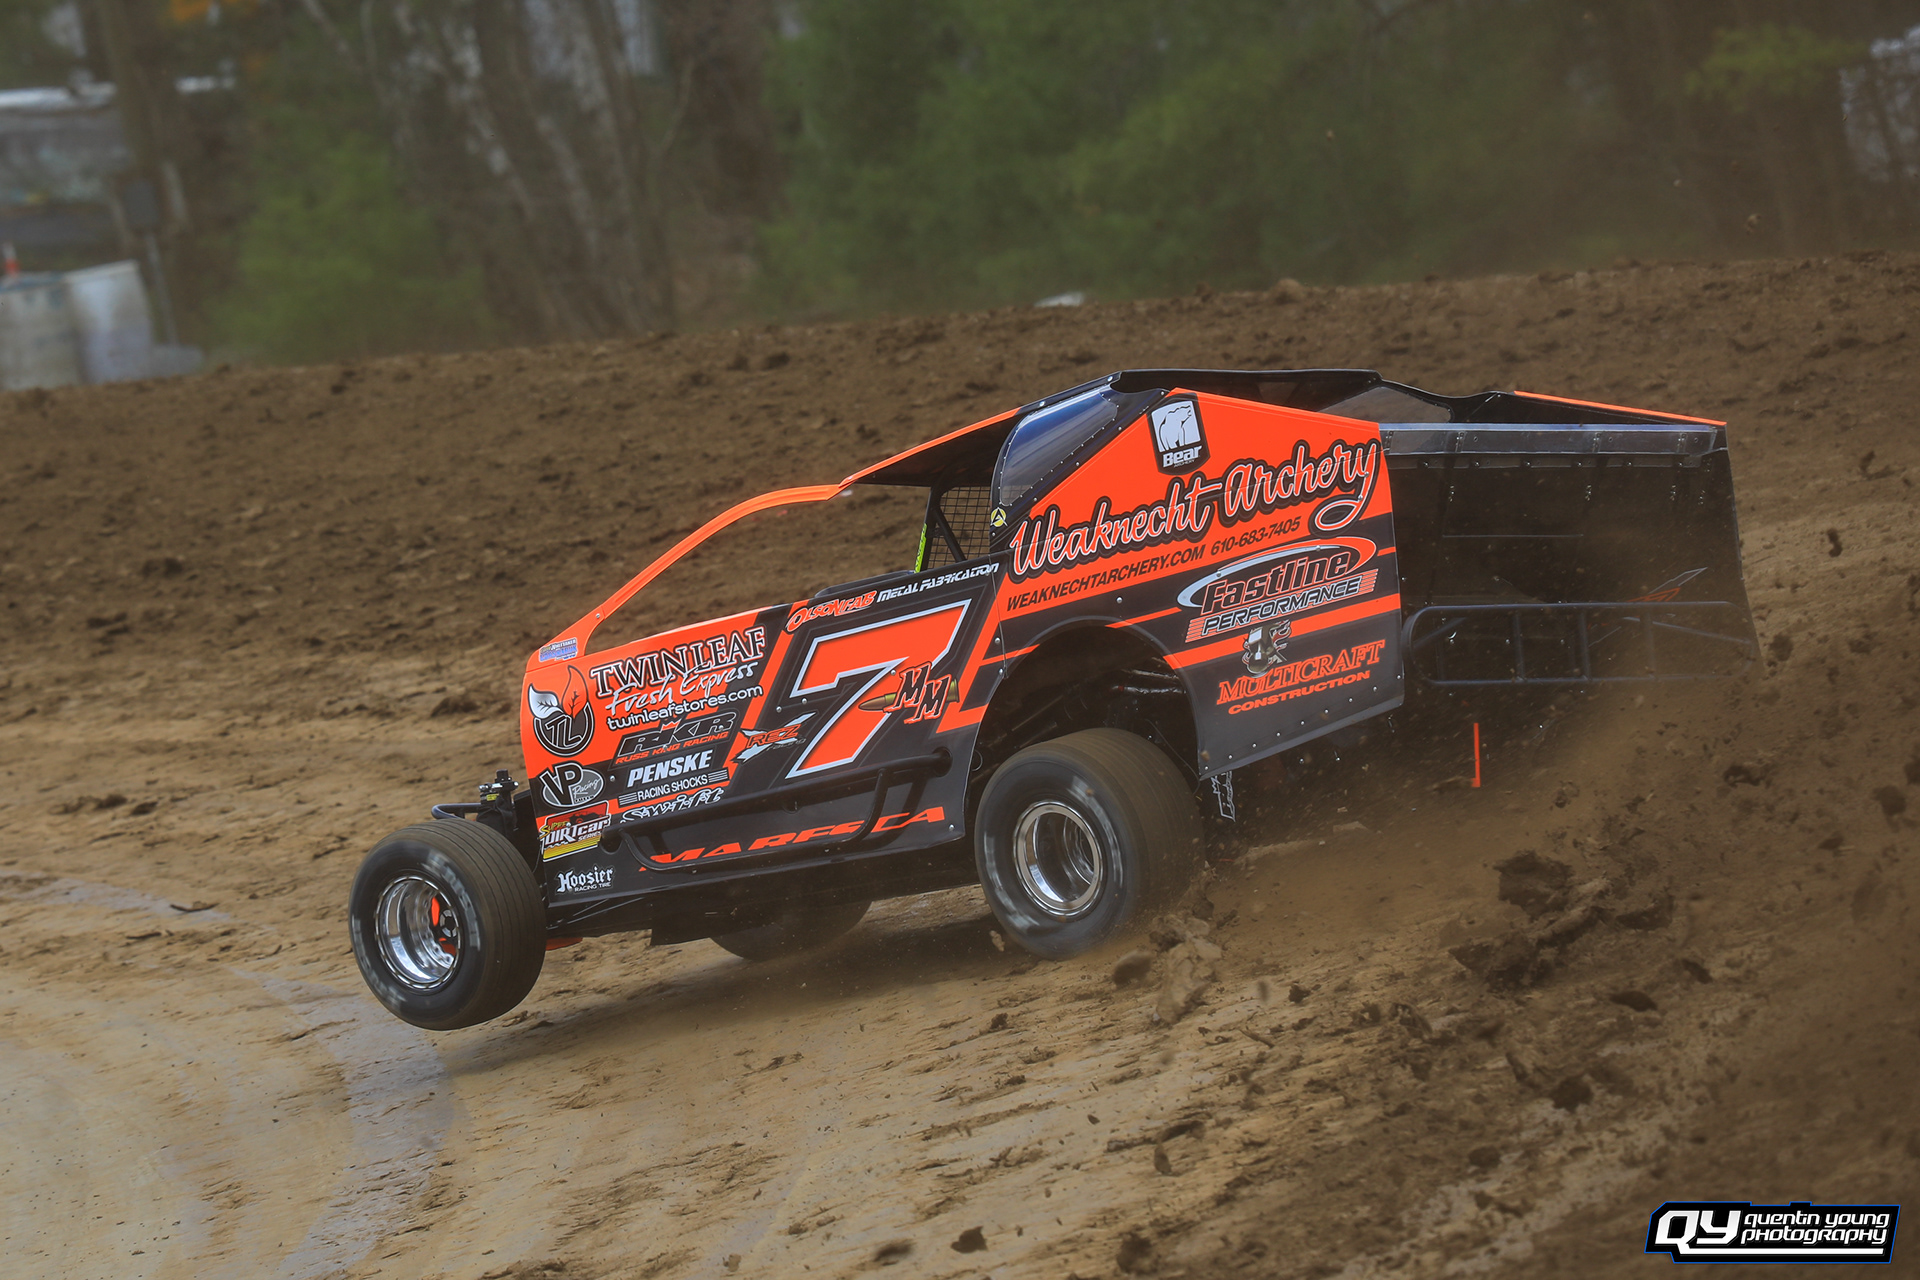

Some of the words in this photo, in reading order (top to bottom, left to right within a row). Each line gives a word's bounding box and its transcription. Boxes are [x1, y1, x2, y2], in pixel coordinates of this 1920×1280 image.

[1163, 446, 1202, 468] Bear
[1010, 477, 1222, 576] Weaknecht
[1224, 442, 1377, 531] Archery
[1007, 544, 1205, 611] WEAKNECHTARCHERY.COM
[1211, 517, 1301, 556] 610-683-7405
[1200, 552, 1351, 615] Fastline
[1201, 576, 1363, 635] PERFORMANCE
[591, 626, 766, 698] TWINLEAF
[1216, 639, 1386, 705] MULTICRAFT
[605, 674, 674, 716] Fresh
[680, 661, 759, 698] Express
[607, 685, 763, 730] twinleafstores.com
[785, 599, 972, 779] 7
[1228, 670, 1371, 715] CONSTRUCTION
[615, 751, 650, 765] RUSS
[652, 743, 681, 756] KING
[683, 731, 729, 748] RACING
[627, 749, 714, 788] PENSKE
[539, 762, 584, 806] VP
[572, 778, 602, 798] Racing
[637, 784, 671, 801] RACING
[671, 775, 709, 792] SHOCKS
[557, 866, 614, 892] Hoosier
[574, 883, 598, 892] RACING
